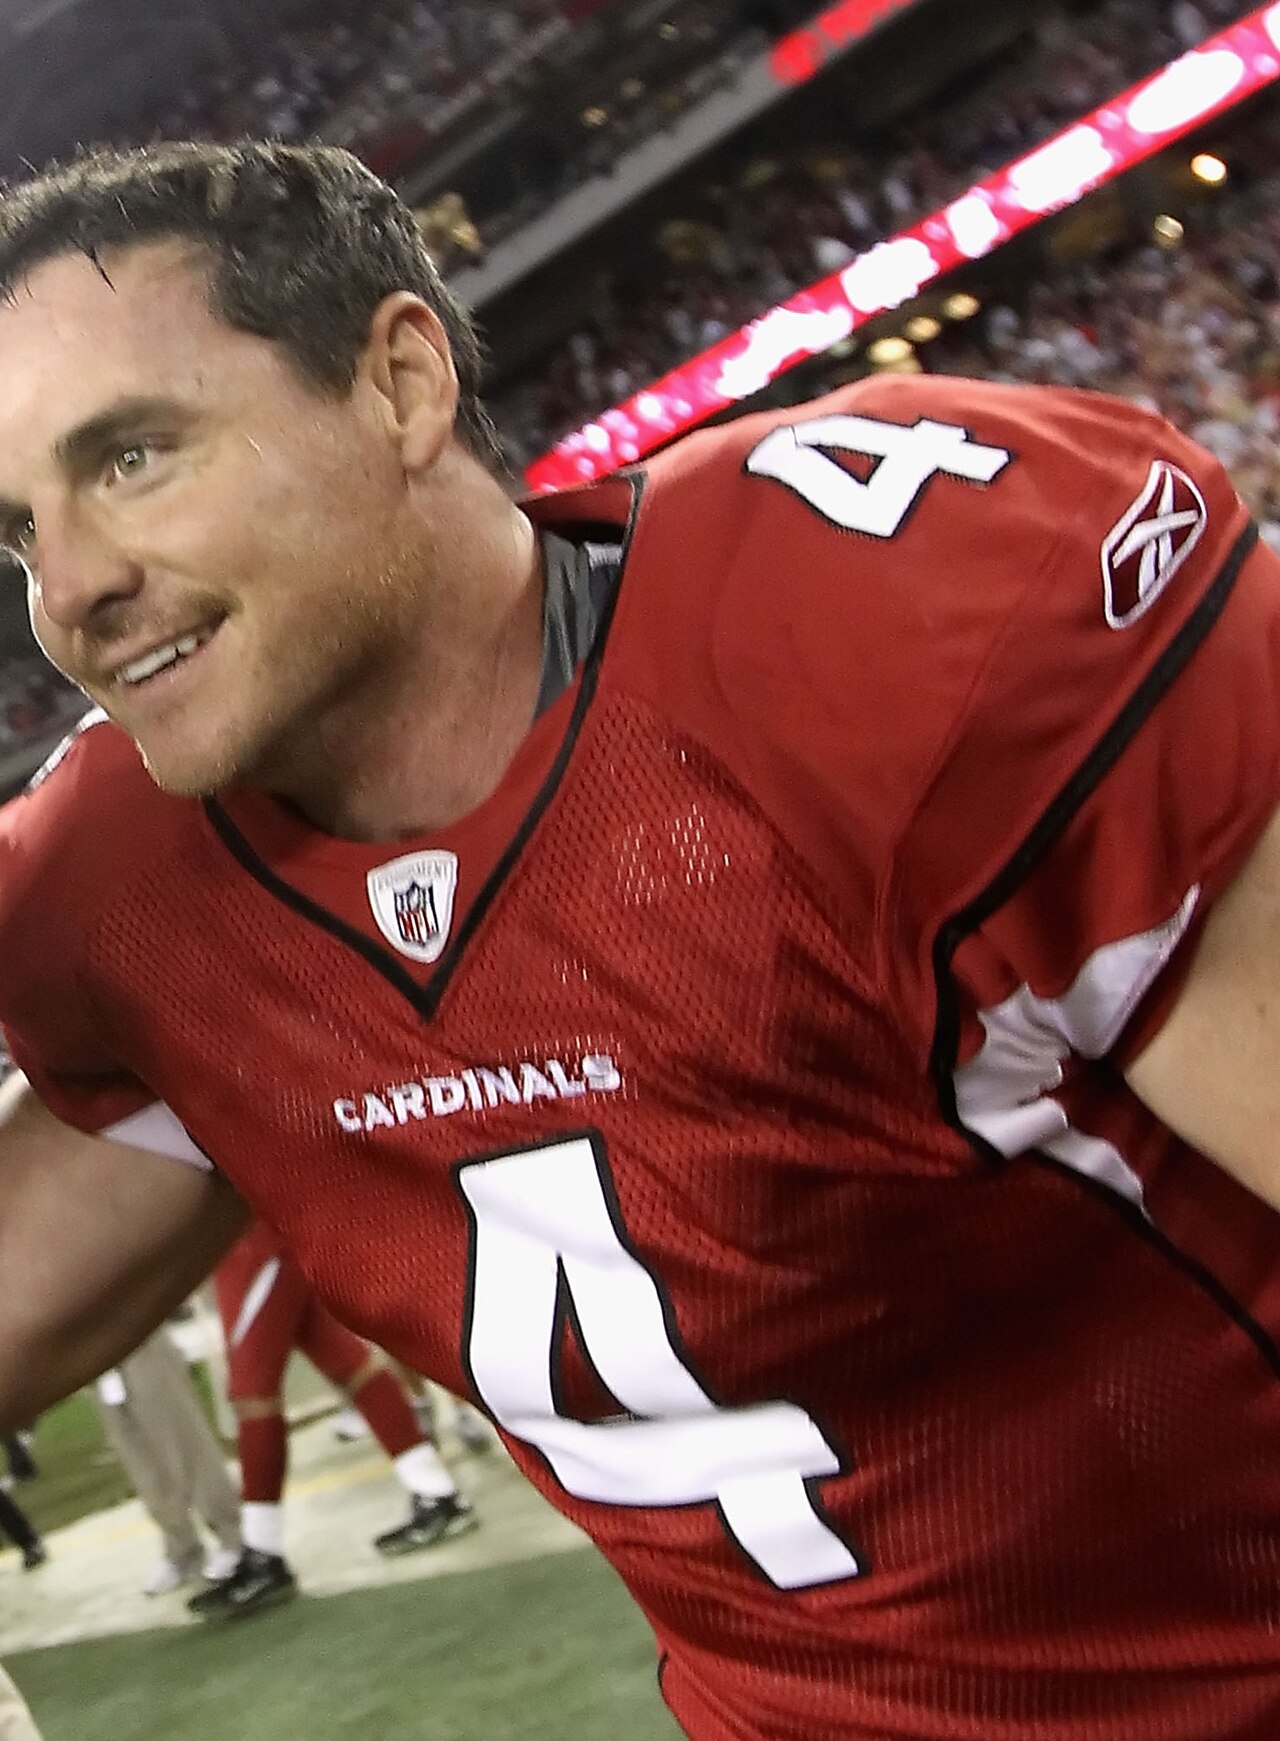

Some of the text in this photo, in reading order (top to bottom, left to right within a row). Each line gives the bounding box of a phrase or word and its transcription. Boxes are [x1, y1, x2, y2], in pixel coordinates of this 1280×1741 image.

[742, 412, 1015, 540] 4
[332, 1054, 620, 1132] CARDINALS
[453, 1130, 866, 1591] 4
